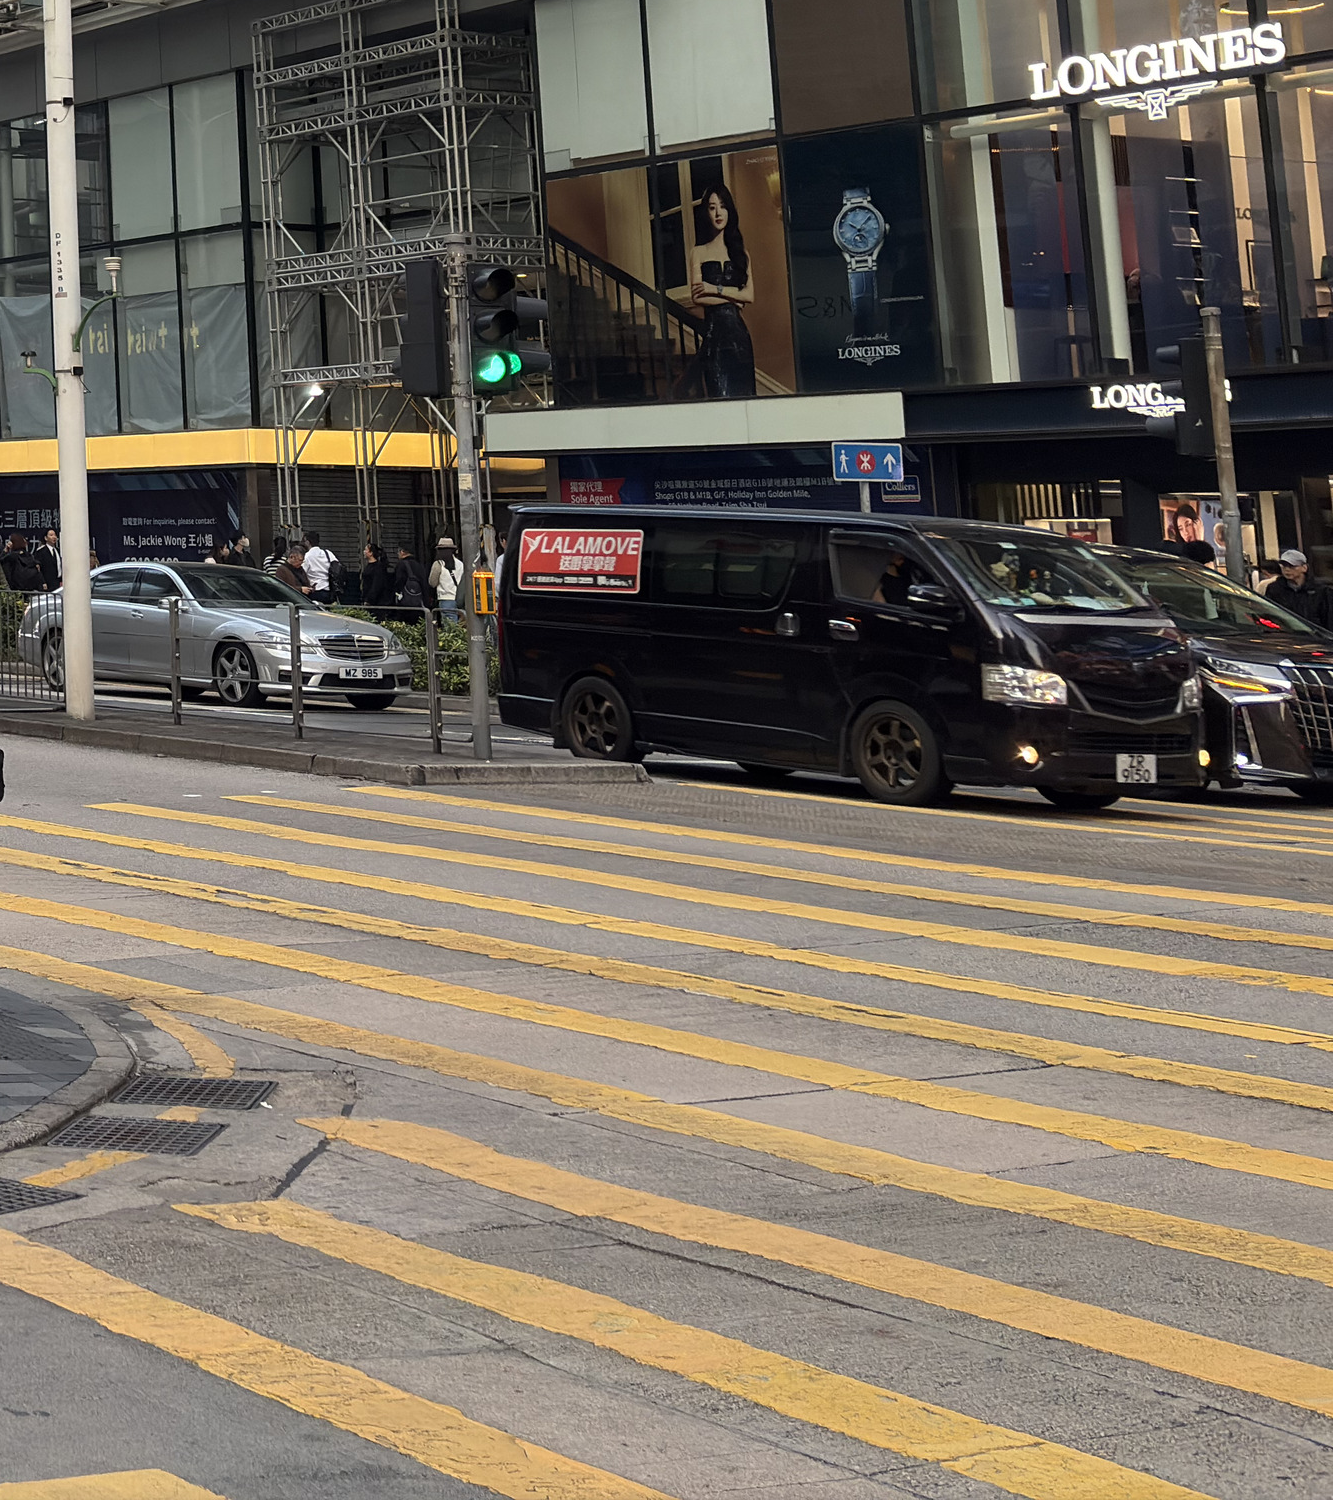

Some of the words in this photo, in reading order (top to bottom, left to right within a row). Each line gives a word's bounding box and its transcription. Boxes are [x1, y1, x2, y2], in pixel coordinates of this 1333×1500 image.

[1028, 22, 1286, 100] LONGINES
[838, 345, 901, 359] LONGINES
[885, 481, 916, 492] Colliers
[570, 494, 588, 503] Sole
[588, 494, 614, 505] Agent
[728, 490, 753, 500] Holiday
[754, 490, 766, 498] Inn
[767, 489, 793, 498] Golden
[153, 517, 177, 527] inquiries,
[178, 517, 194, 526] please
[123, 535, 137, 546] Ms.
[138, 534, 163, 548] Jackie
[163, 535, 187, 549] Wong
[188, 534, 213, 547] 王小姐
[540, 536, 642, 555] LALAMOVE
[345, 668, 358, 678] MZ
[361, 668, 378, 678] 985
[1128, 754, 1146, 769] ZR
[1122, 768, 1152, 783] 9150
